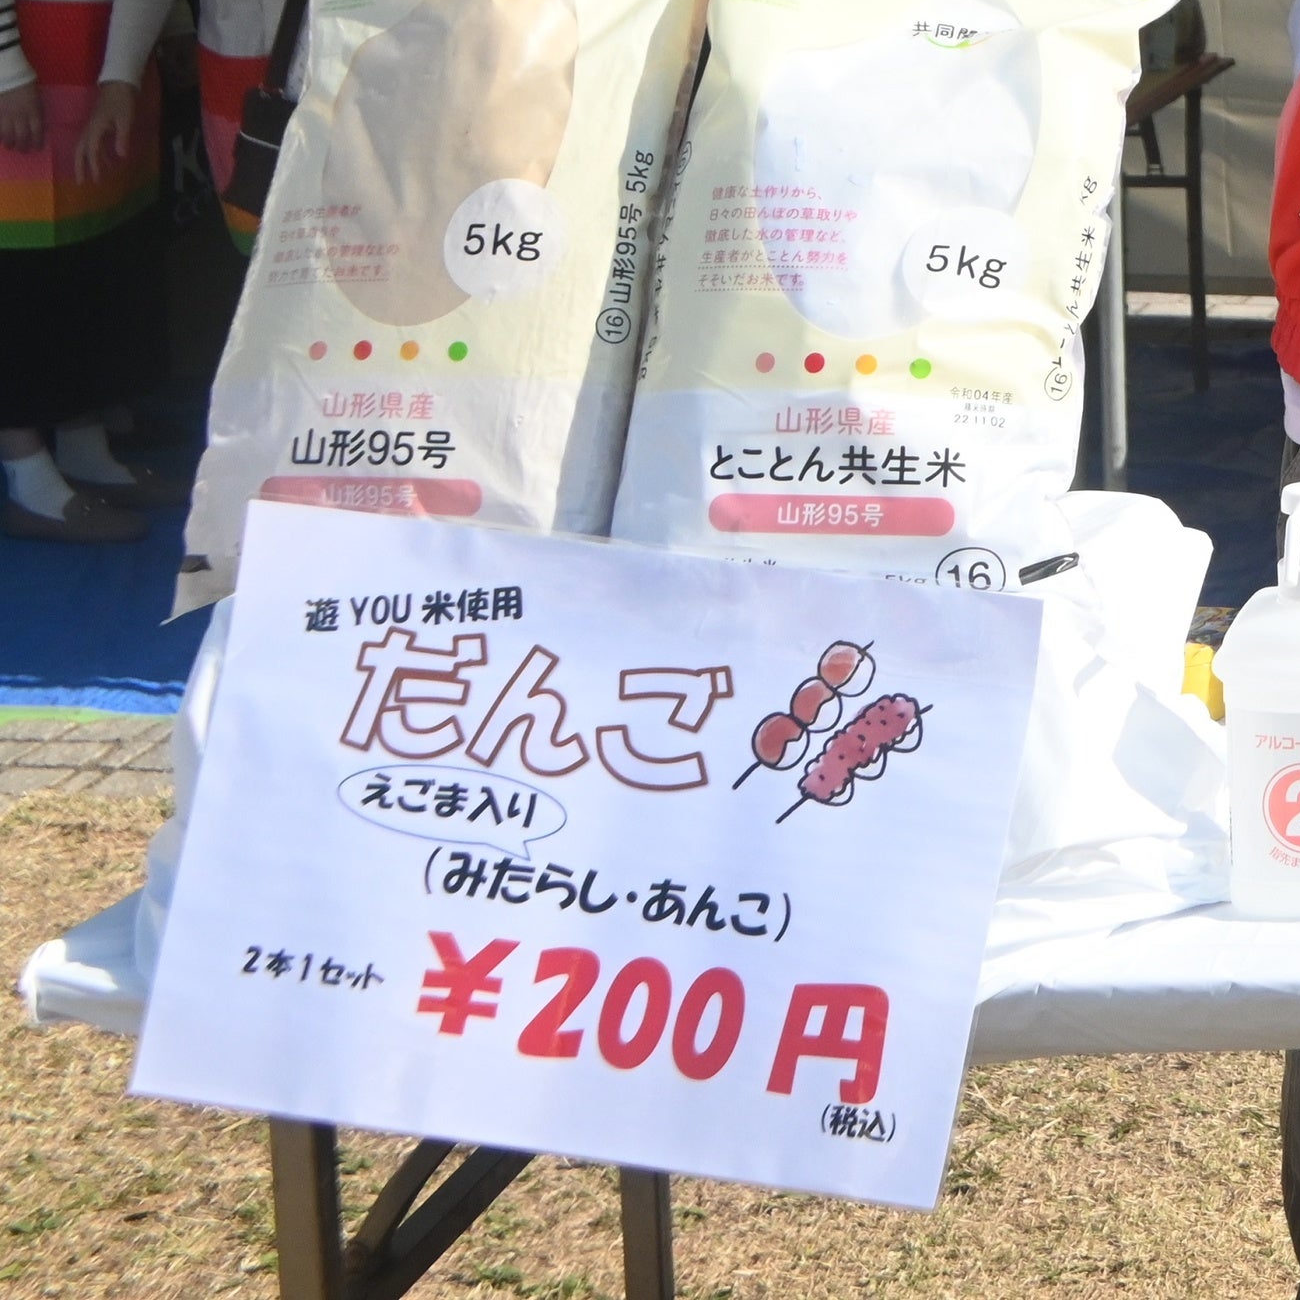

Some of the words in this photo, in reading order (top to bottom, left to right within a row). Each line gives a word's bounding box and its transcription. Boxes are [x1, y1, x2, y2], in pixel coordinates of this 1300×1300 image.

[626, 149, 654, 193] 5kg
[463, 223, 543, 261] 5kg
[701, 250, 848, 265] 生産者がとことん努力を
[926, 244, 1007, 289] 5kg
[323, 391, 434, 419] 山形県産
[776, 406, 896, 436] 山形県産
[291, 428, 456, 469] 山形95号
[710, 445, 966, 488] とことん共生米
[777, 502, 884, 528] 山形95号
[305, 598, 339, 632] 遊
[350, 593, 412, 626] YOU
[421, 586, 524, 625] 米使用
[340, 626, 734, 792] だんご
[361, 773, 538, 829] えごま入り
[820, 1102, 896, 1143] (税込)
